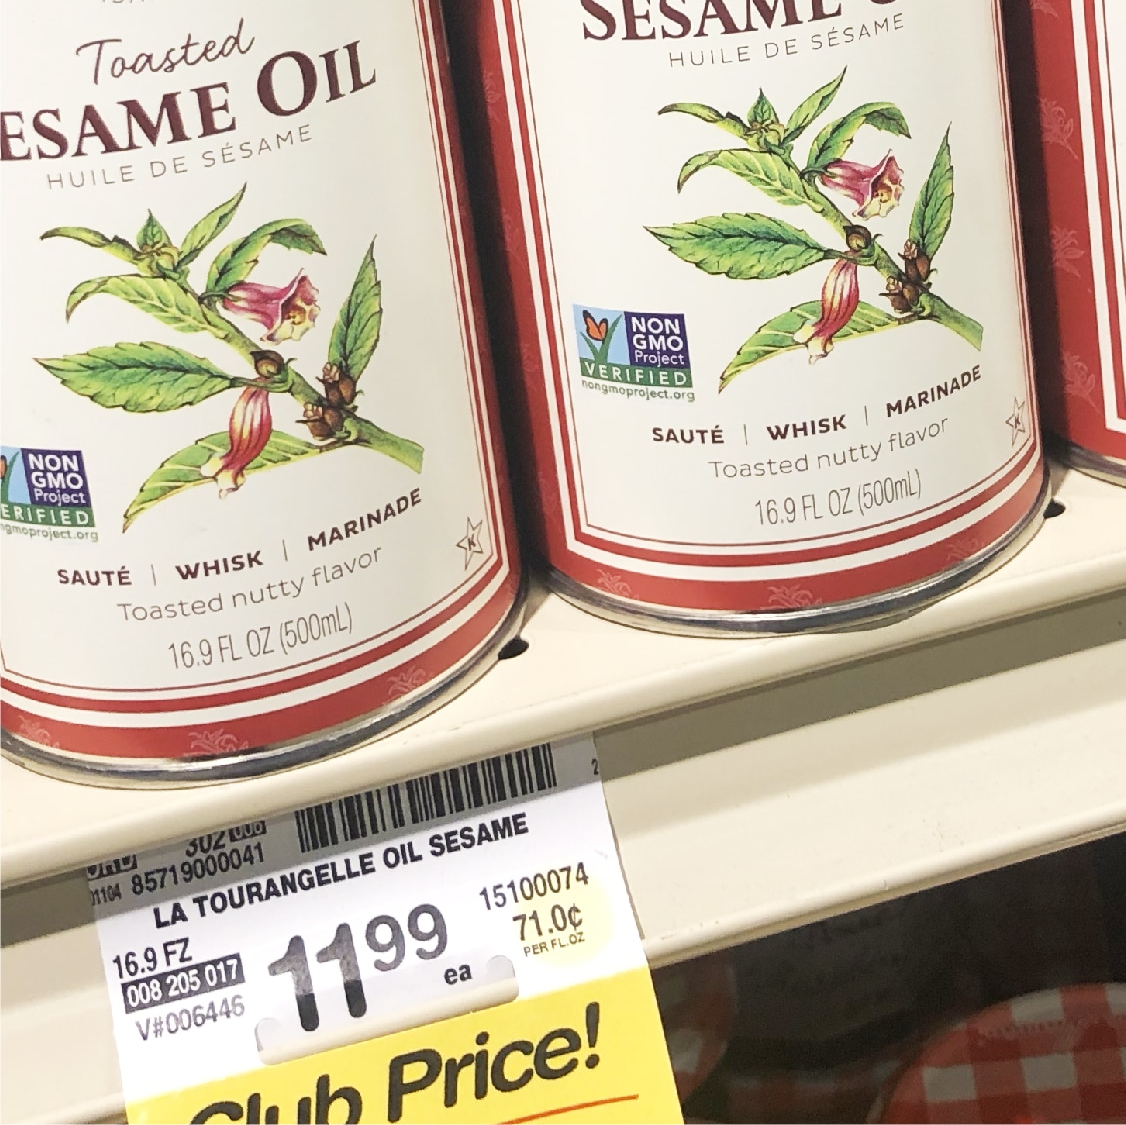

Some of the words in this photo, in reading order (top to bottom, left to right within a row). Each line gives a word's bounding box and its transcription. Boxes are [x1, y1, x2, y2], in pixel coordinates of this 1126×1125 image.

[75, 17, 256, 86] Toasted
[668, 46, 752, 69] HUILE
[764, 39, 798, 59] DE
[811, 12, 905, 51] SÉSAME
[256, 40, 377, 117] OIL
[47, 165, 135, 190] HUILE
[150, 156, 189, 178] DE
[201, 124, 312, 167] SÉSAME
[631, 315, 682, 336] NON
[632, 332, 684, 352] GMO
[584, 361, 687, 386] VERIFIED
[634, 349, 685, 369] Project
[581, 378, 696, 402] nongmoproject.org
[651, 424, 725, 445] SAUTÉ
[766, 413, 847, 442] WHISK
[885, 364, 982, 419] MARINADE
[28, 453, 79, 472] NON
[708, 454, 810, 480] Toasted
[817, 438, 882, 470] nutty
[889, 414, 950, 453] flavor
[31, 471, 84, 490] GMO
[34, 488, 86, 507] Project
[754, 496, 798, 527] 16.9
[802, 493, 825, 521] FL
[828, 488, 853, 517] OZ
[857, 468, 923, 517] (500mL)
[56, 565, 133, 588] SAUTÉ
[174, 550, 264, 582] WHISK
[306, 488, 423, 553] MARINADE
[116, 593, 224, 623] Toasted
[232, 575, 305, 609] nutty
[311, 546, 383, 589] flavor
[168, 635, 213, 670] 16.9
[217, 632, 243, 663] FL
[246, 626, 275, 657] OZ
[280, 601, 354, 656] (500mL)
[131, 842, 264, 895] 85719000041
[153, 902, 188, 929] LA
[193, 851, 376, 918] TOURANGELLE
[382, 838, 423, 868] OIL
[428, 812, 529, 857] SESAME
[479, 861, 589, 912] 15100074
[512, 904, 584, 943] 71.0¢
[523, 940, 549, 958] PER
[551, 931, 585, 951] FL.OZ
[112, 947, 158, 979] 16.9
[162, 937, 194, 967] FZ
[443, 961, 472, 987] ea
[126, 979, 164, 1008] 008
[166, 969, 201, 998] 205
[203, 959, 240, 989] 017
[135, 995, 246, 1042] V#006446
[387, 1002, 600, 1124] Price!
